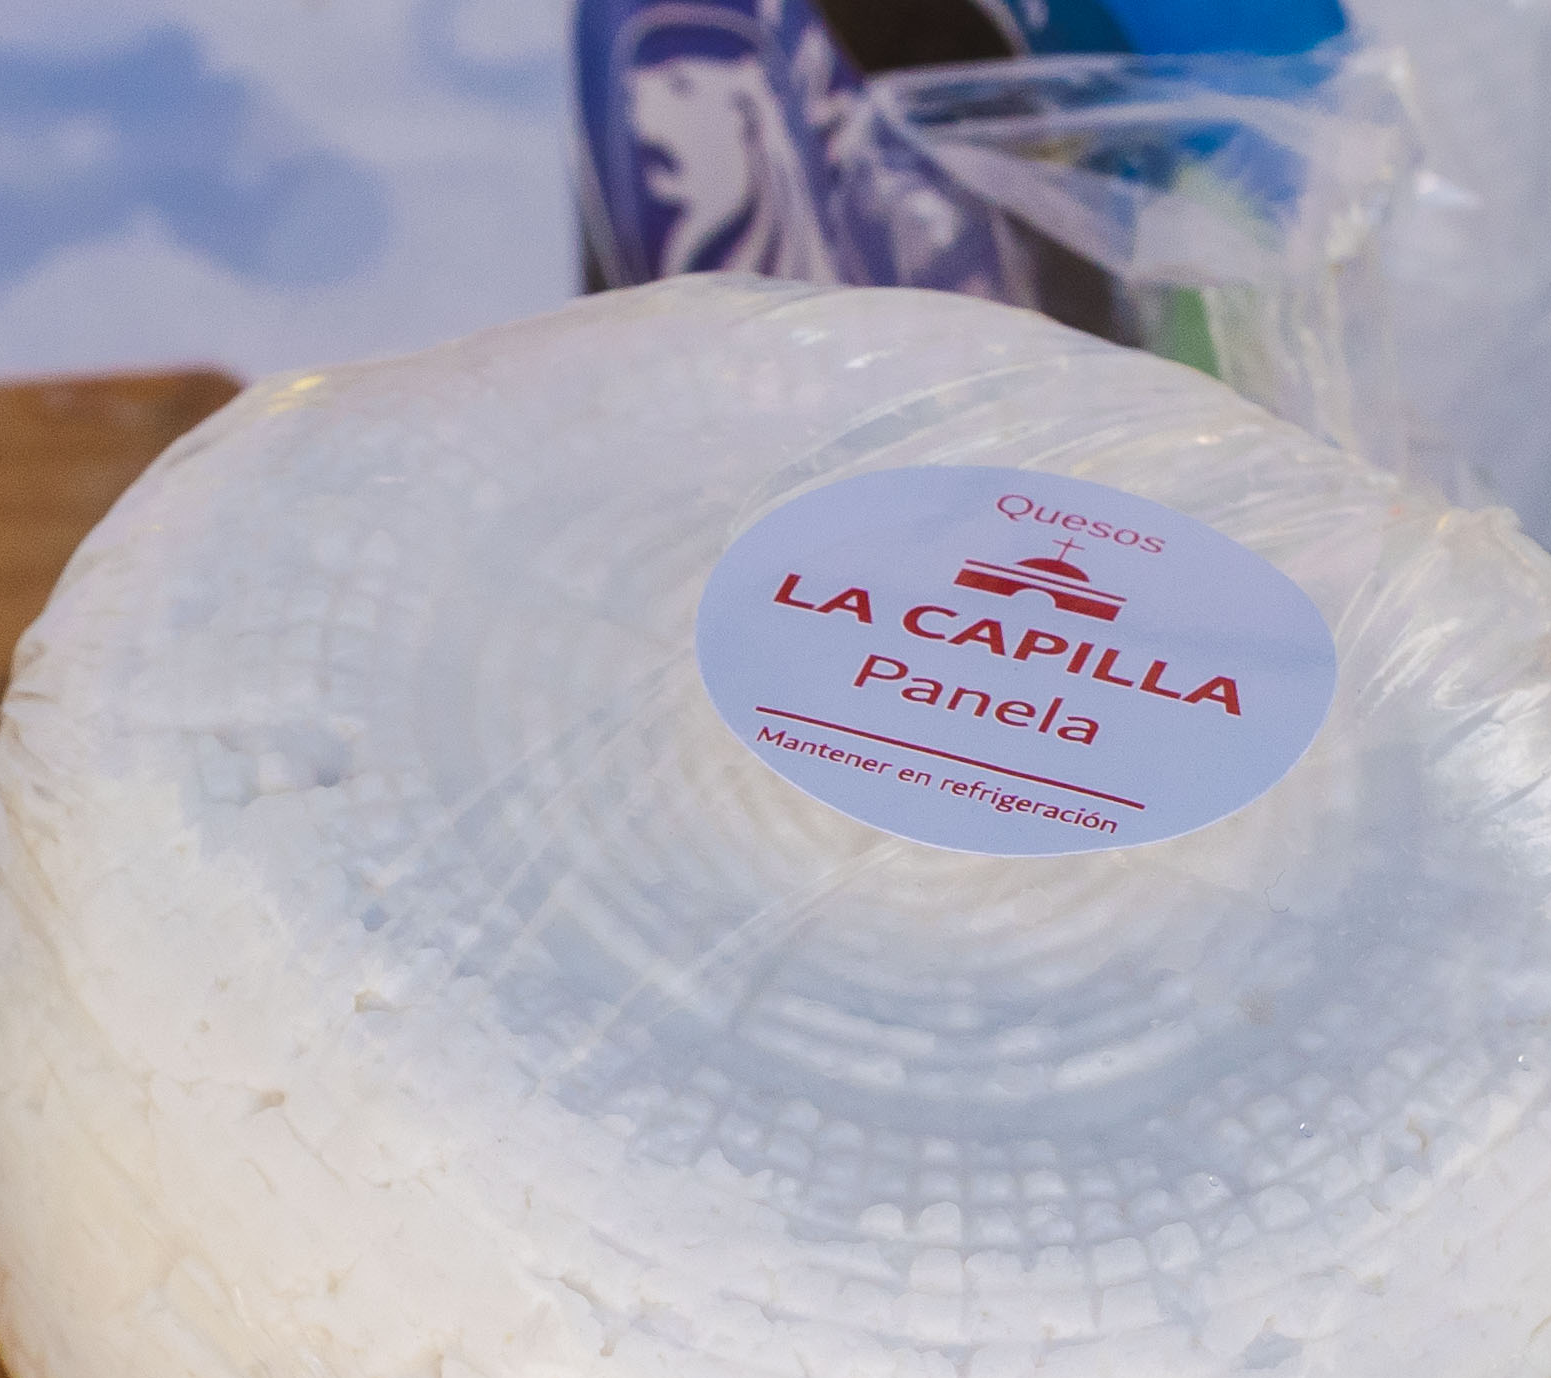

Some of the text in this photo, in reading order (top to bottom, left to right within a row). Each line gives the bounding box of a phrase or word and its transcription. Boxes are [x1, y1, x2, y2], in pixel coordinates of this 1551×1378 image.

[994, 493, 1167, 555] Quesos
[773, 573, 1243, 717] LA CAPILLA
[852, 654, 1102, 746] Panela
[755, 726, 1119, 835] Mantener en refrigeración
